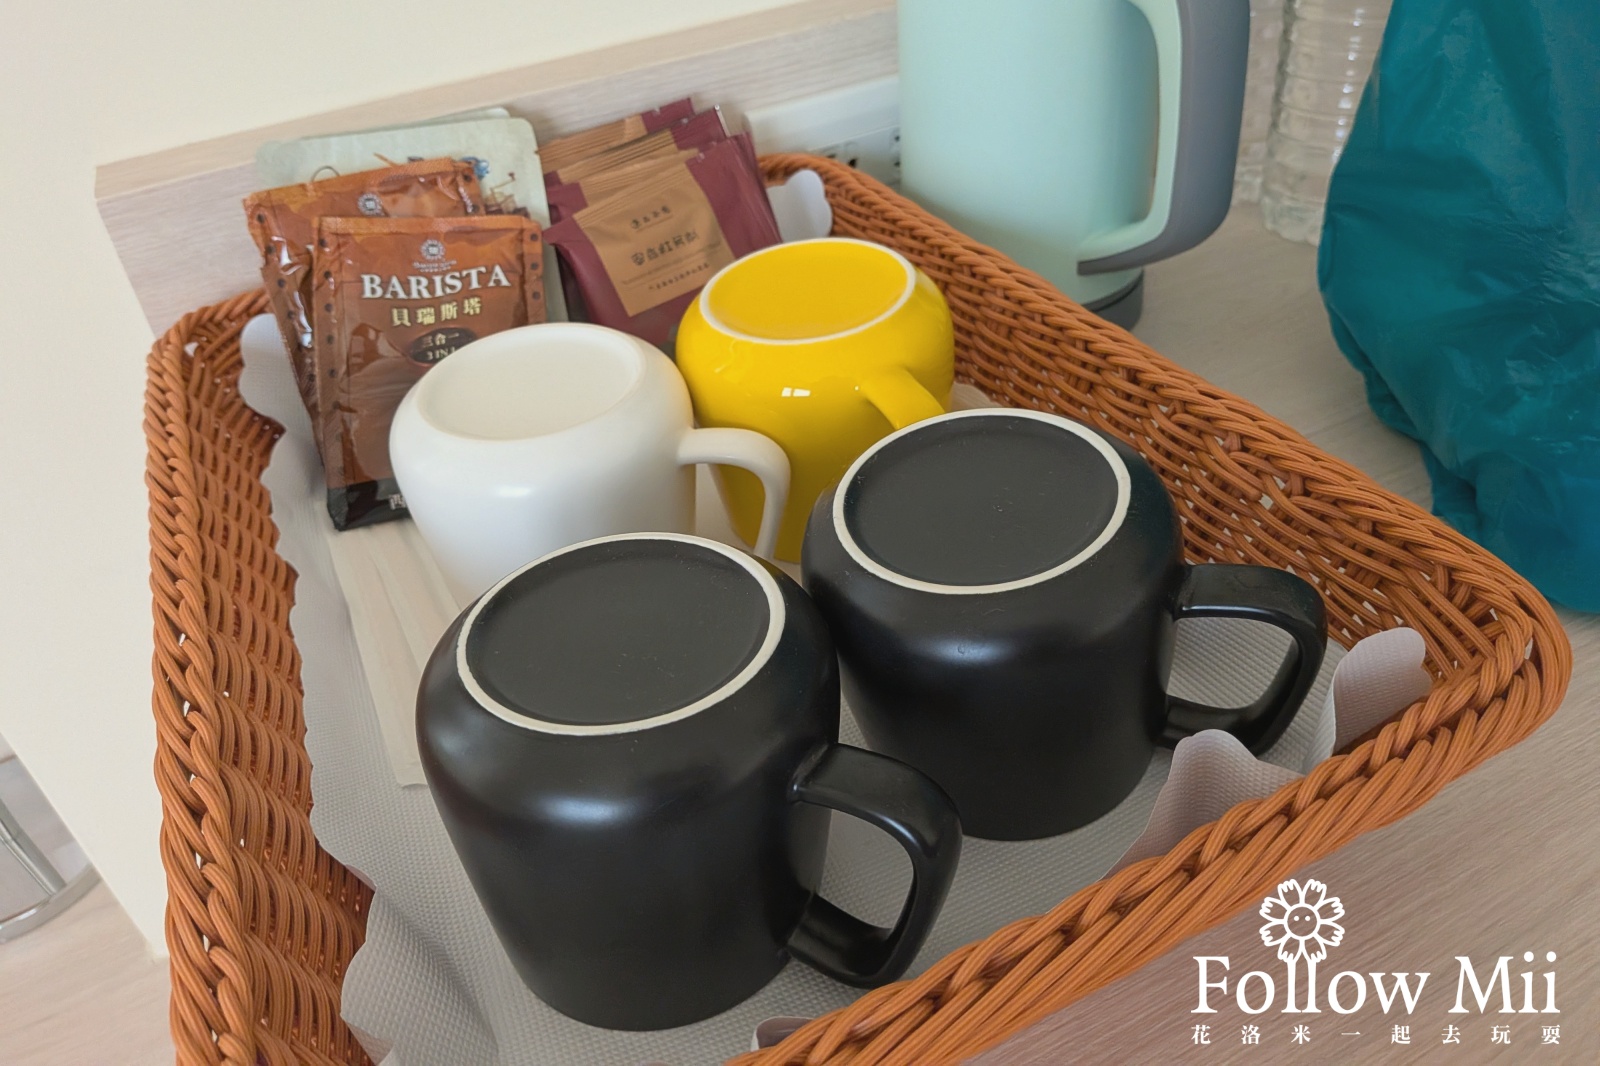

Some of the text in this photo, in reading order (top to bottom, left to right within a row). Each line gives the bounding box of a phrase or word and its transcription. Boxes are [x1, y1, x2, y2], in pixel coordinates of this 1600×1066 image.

[361, 264, 511, 300] BARISTA
[391, 297, 482, 327] 貝瑞斯塔
[421, 332, 460, 348] 三合一
